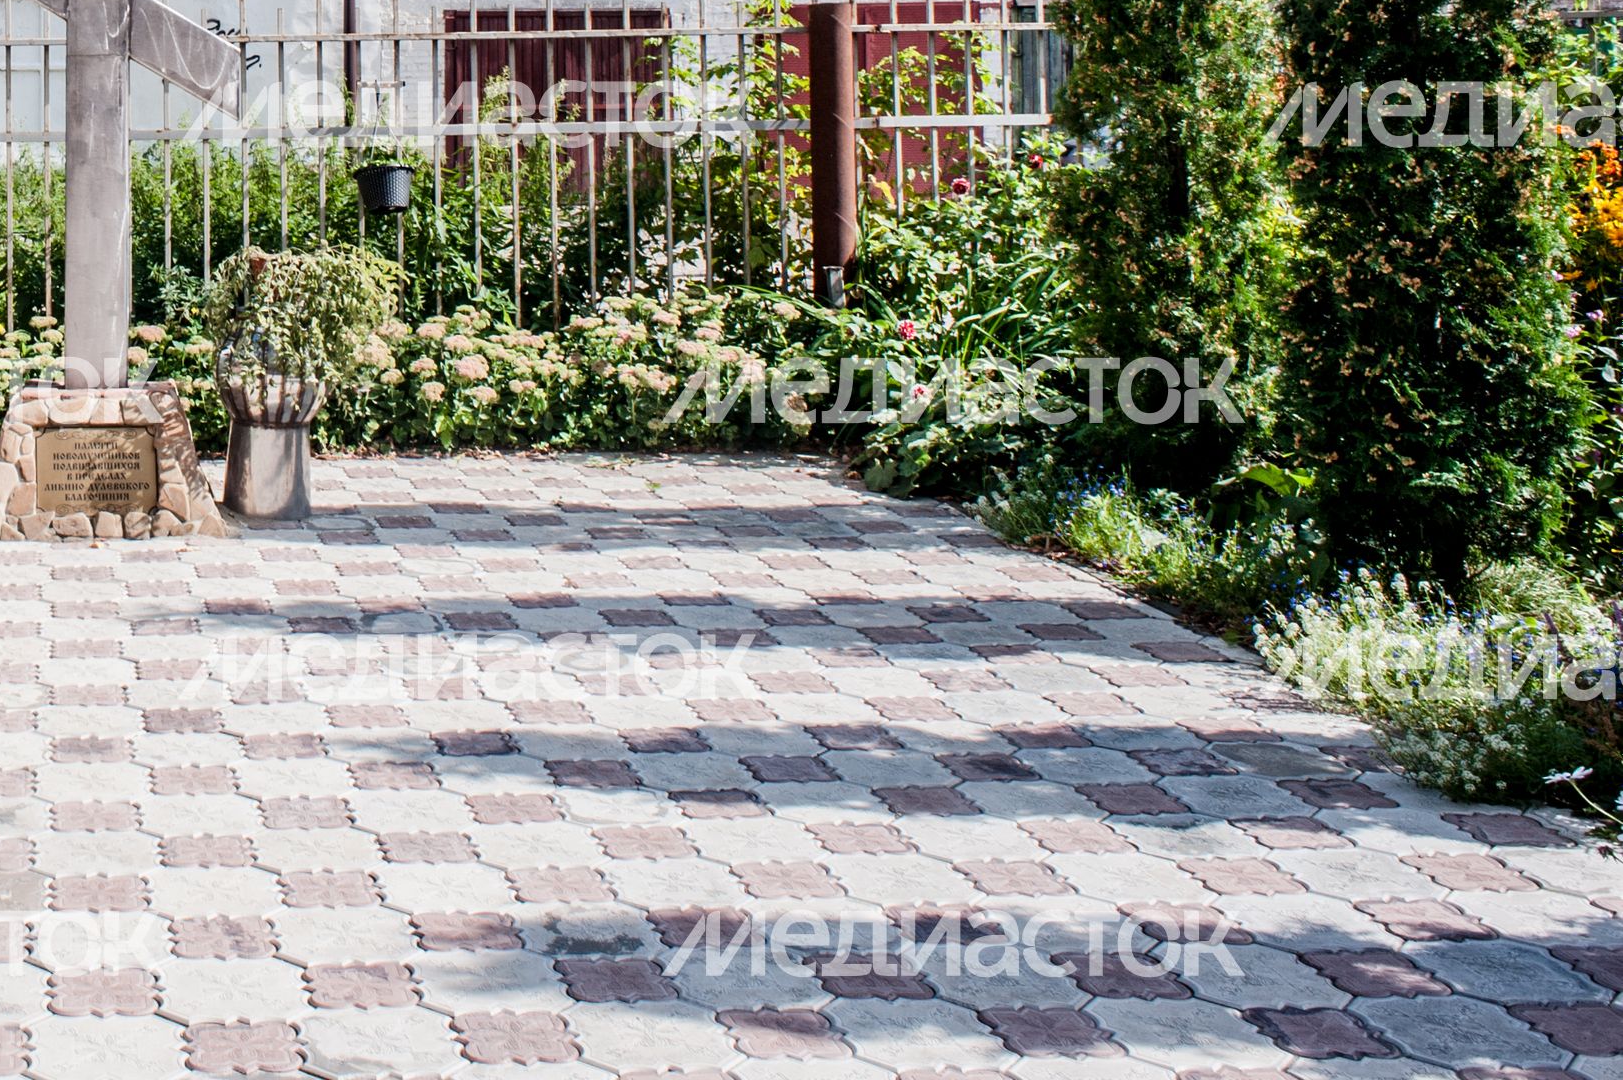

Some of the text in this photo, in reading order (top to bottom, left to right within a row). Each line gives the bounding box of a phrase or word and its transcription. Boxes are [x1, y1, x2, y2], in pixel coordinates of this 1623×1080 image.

[74, 442, 118, 450] ПАМЯТИ
[67, 472, 127, 481] В ПРЕДЕЛАХ
[44, 482, 150, 492] ЛИКИНО ДУЛЕВСКОГО
[65, 493, 130, 501] БЛАГОЧИНИЯ
